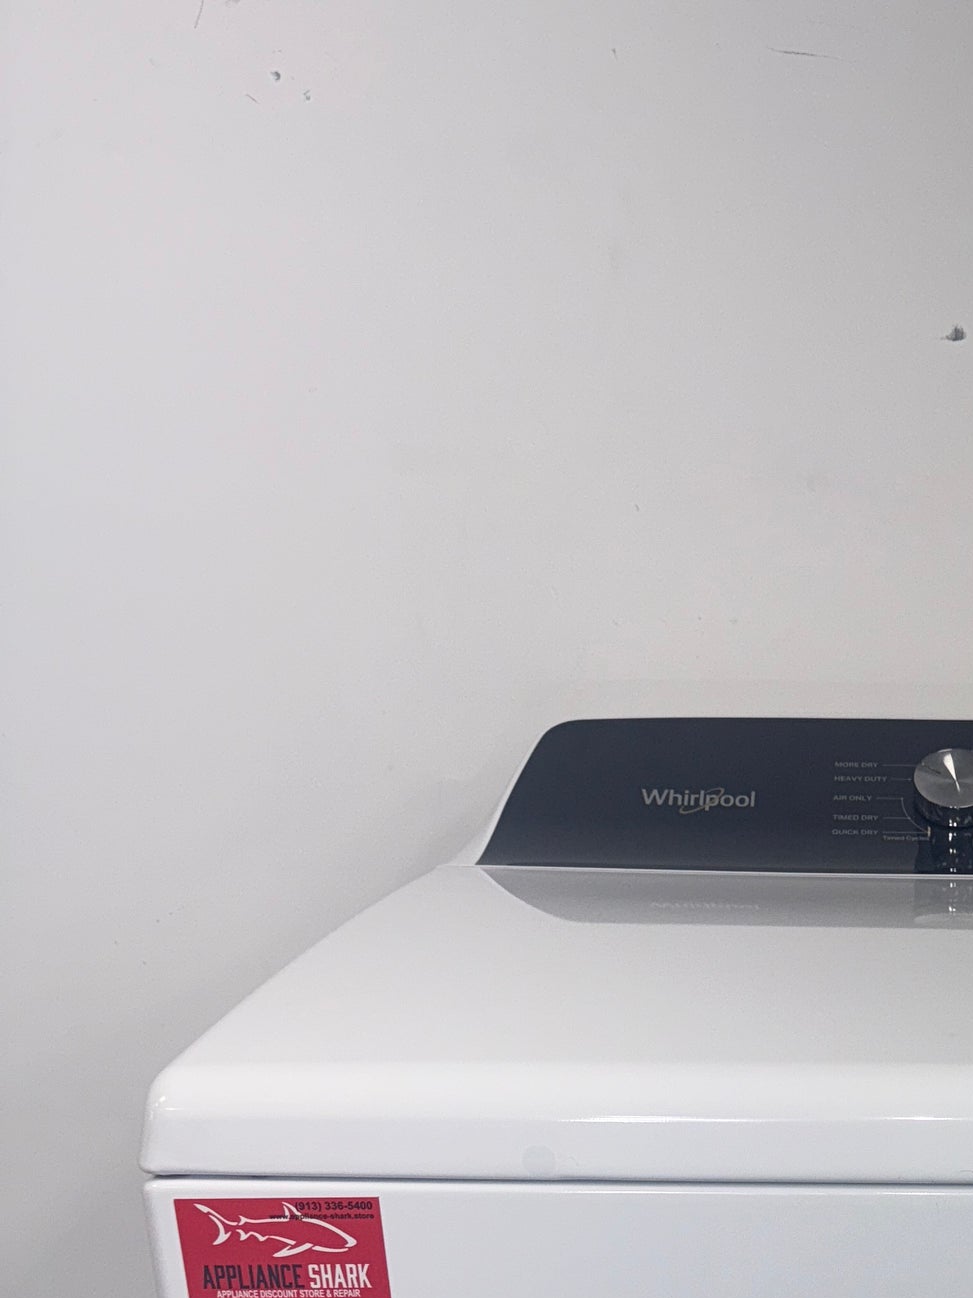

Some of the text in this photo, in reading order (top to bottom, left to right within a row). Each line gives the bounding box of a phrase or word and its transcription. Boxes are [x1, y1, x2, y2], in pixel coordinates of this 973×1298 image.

[641, 788, 756, 812] Whirlpool
[294, 1201, 373, 1211] (913) 336-5400
[203, 1264, 373, 1290] APPLIANCE SHARK
[217, 1289, 361, 1298] APPLIANCE DISCOUNT STORE & REPAIR
